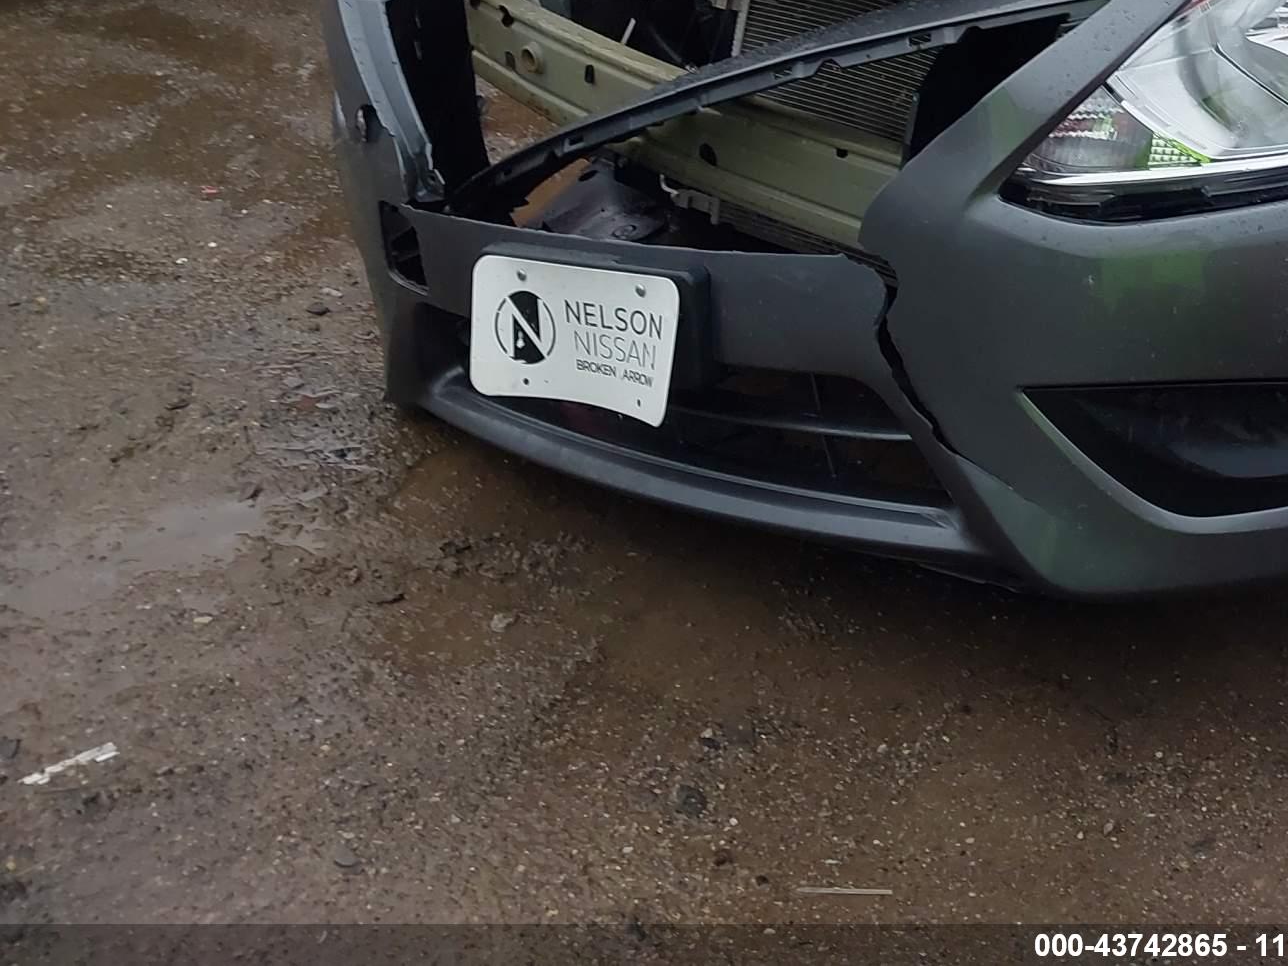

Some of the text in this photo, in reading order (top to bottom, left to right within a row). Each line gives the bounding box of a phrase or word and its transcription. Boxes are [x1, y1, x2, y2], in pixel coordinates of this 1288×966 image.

[564, 299, 663, 340] NELSON
[573, 330, 656, 370] NISSAN
[576, 359, 652, 388] BROKEN ARROW
